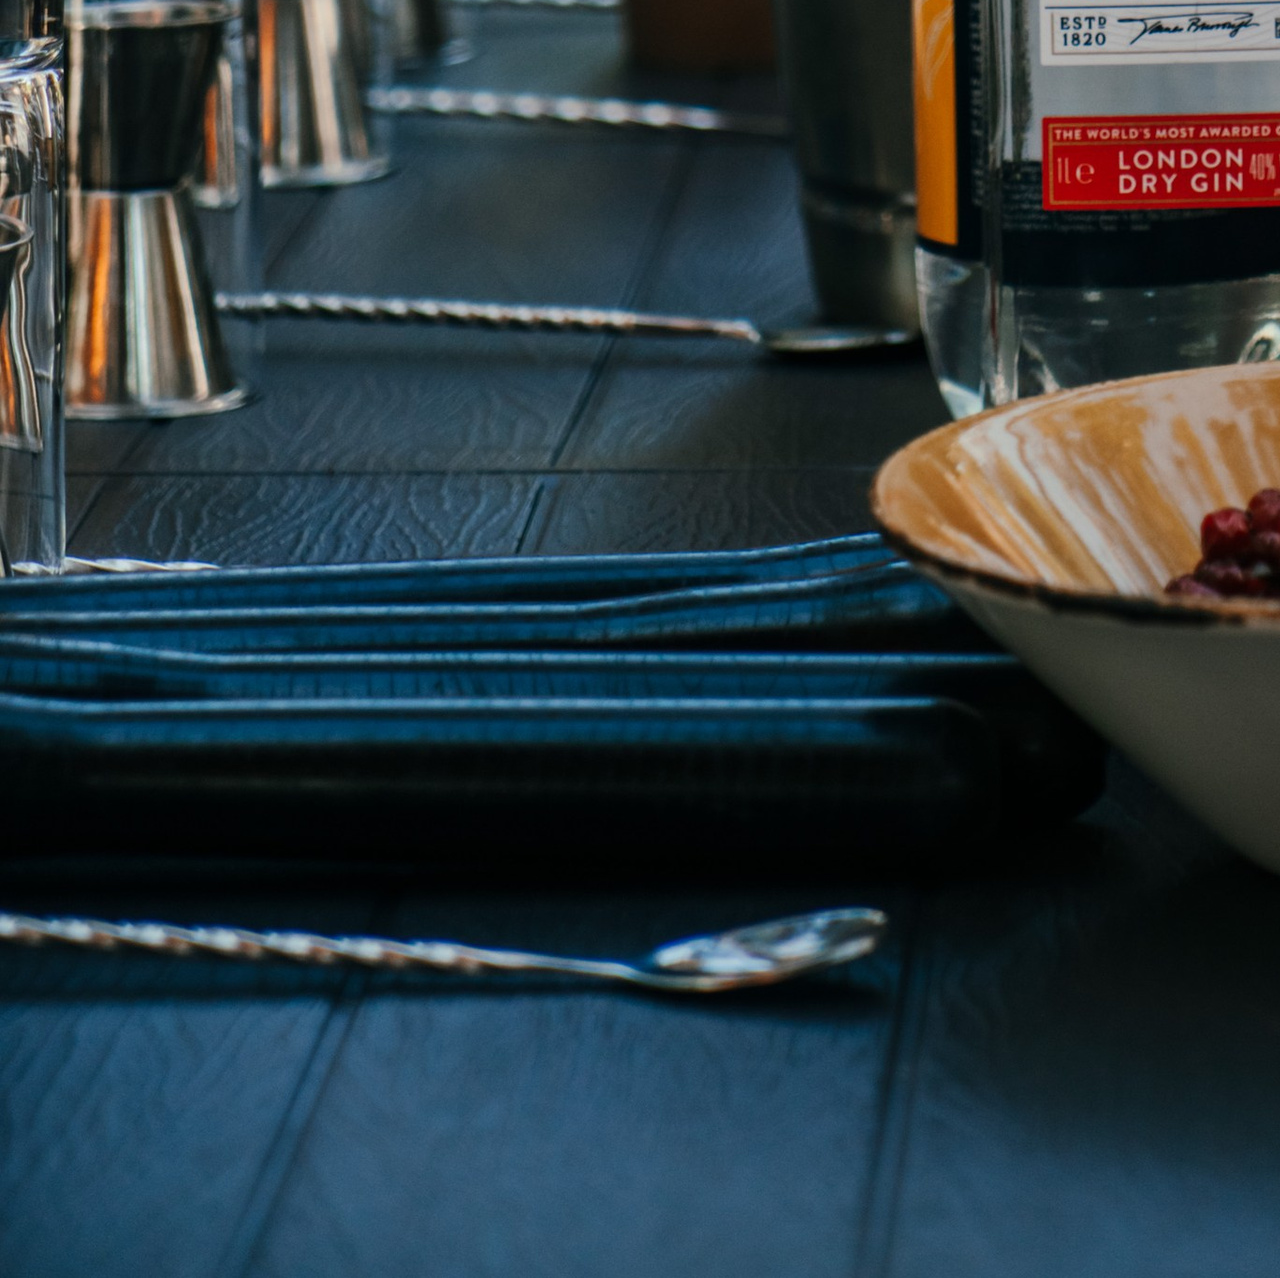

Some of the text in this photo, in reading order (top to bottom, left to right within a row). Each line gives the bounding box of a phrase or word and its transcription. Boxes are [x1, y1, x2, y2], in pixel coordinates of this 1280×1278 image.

[1060, 16, 1107, 31] ESTD
[1062, 32, 1107, 47] 1820
[1055, 128, 1082, 141] THE
[1087, 127, 1151, 140] WORLD'S
[1155, 126, 1195, 139] MOST
[1199, 125, 1271, 138] AWARDED
[1118, 148, 1244, 170] LONDON
[1249, 152, 1276, 181] 40%
[1118, 172, 1244, 194] DRY GIN
